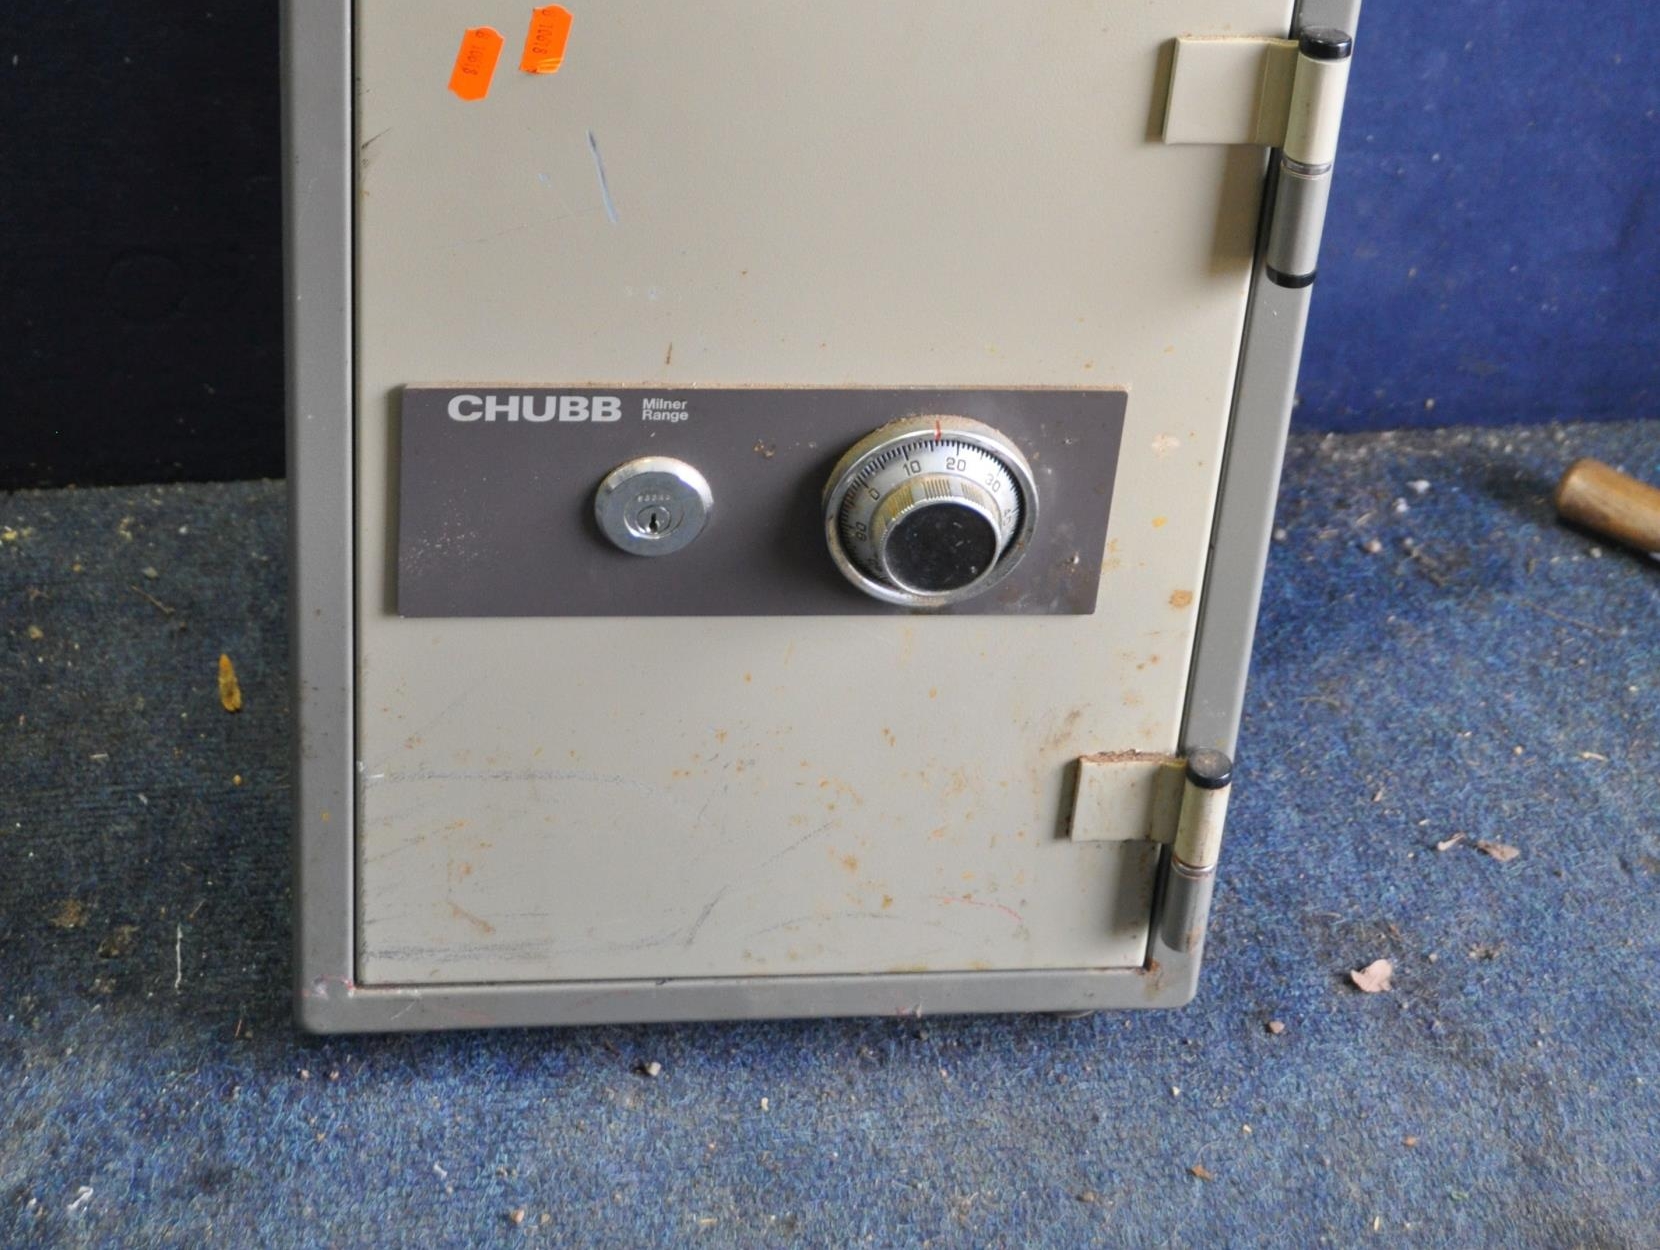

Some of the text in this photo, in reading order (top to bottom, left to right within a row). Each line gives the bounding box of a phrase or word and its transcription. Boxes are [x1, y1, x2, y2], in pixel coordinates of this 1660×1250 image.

[447, 394, 622, 422] CHUBB
[642, 398, 688, 410] Milner
[641, 410, 689, 422] Range
[903, 459, 922, 477] 10
[946, 457, 967, 473] 20
[984, 473, 1001, 493] 30
